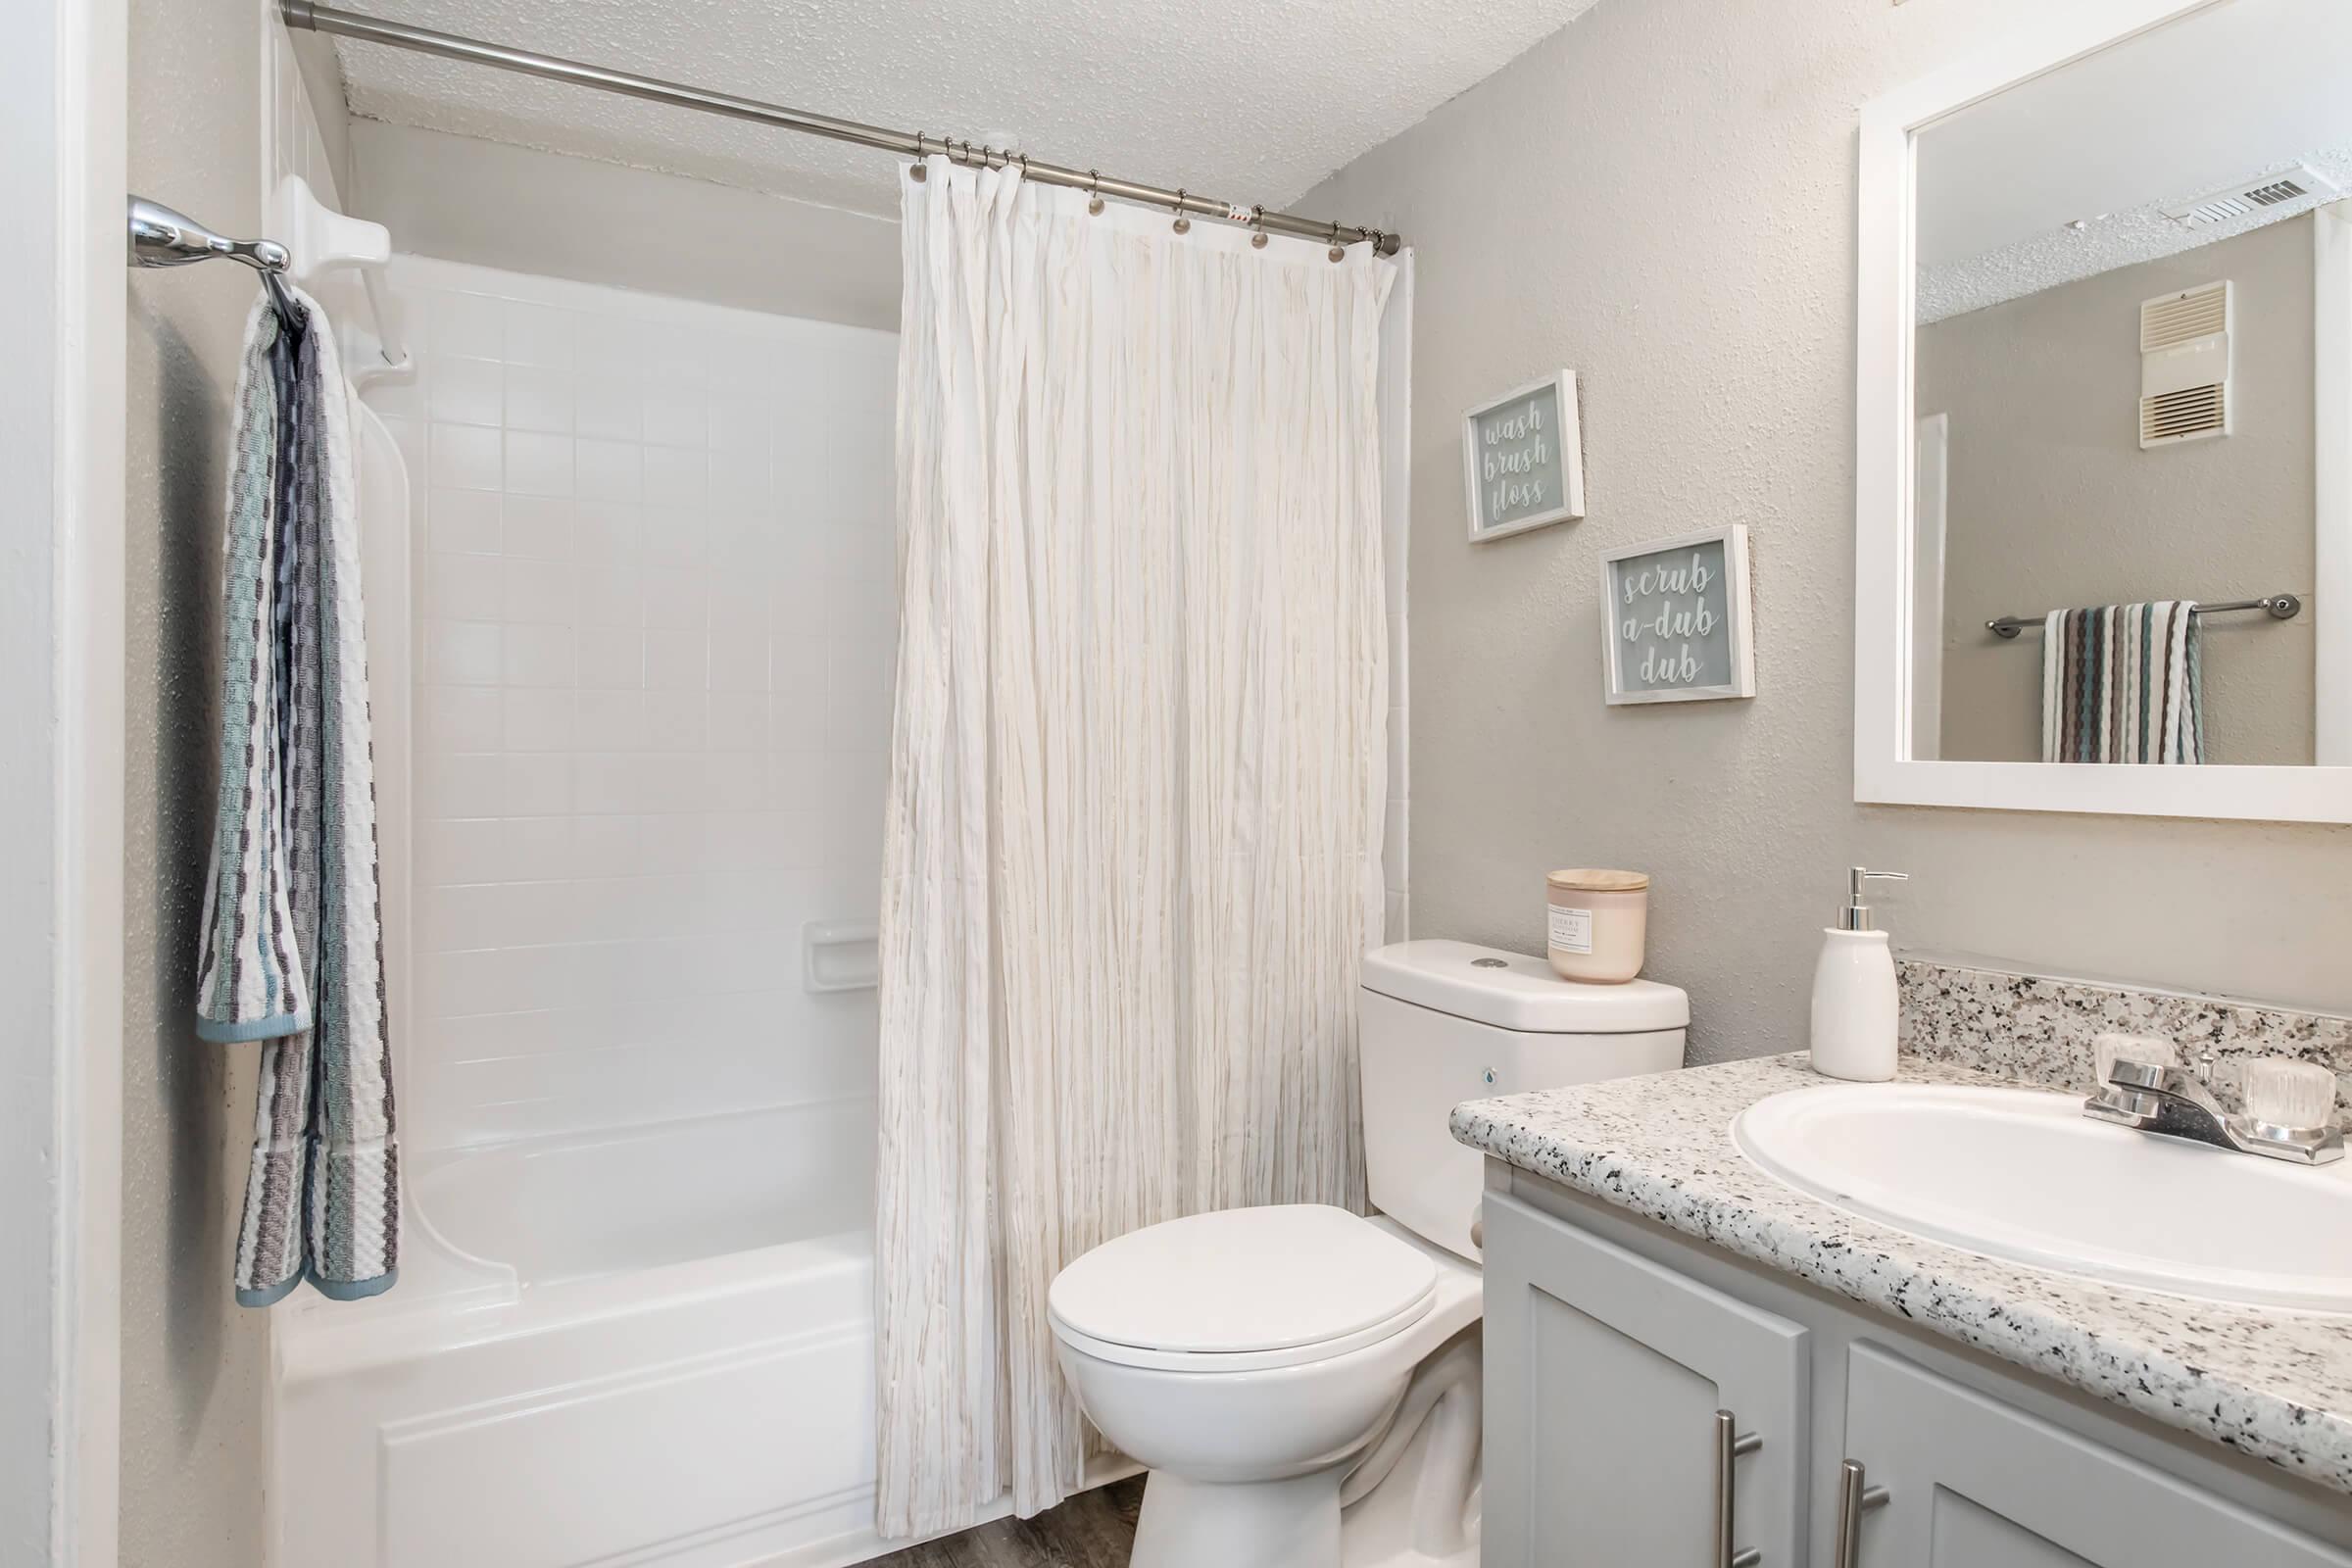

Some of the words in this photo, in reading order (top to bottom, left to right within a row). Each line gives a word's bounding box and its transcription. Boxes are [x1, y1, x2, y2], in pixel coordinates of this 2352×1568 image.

[1486, 400, 1545, 445] wash
[1484, 434, 1552, 482] brush
[1493, 479, 1546, 520] floss
[1624, 553, 1716, 604] scrub
[1622, 596, 1720, 642] a-dub
[1640, 643, 1704, 684] dub
